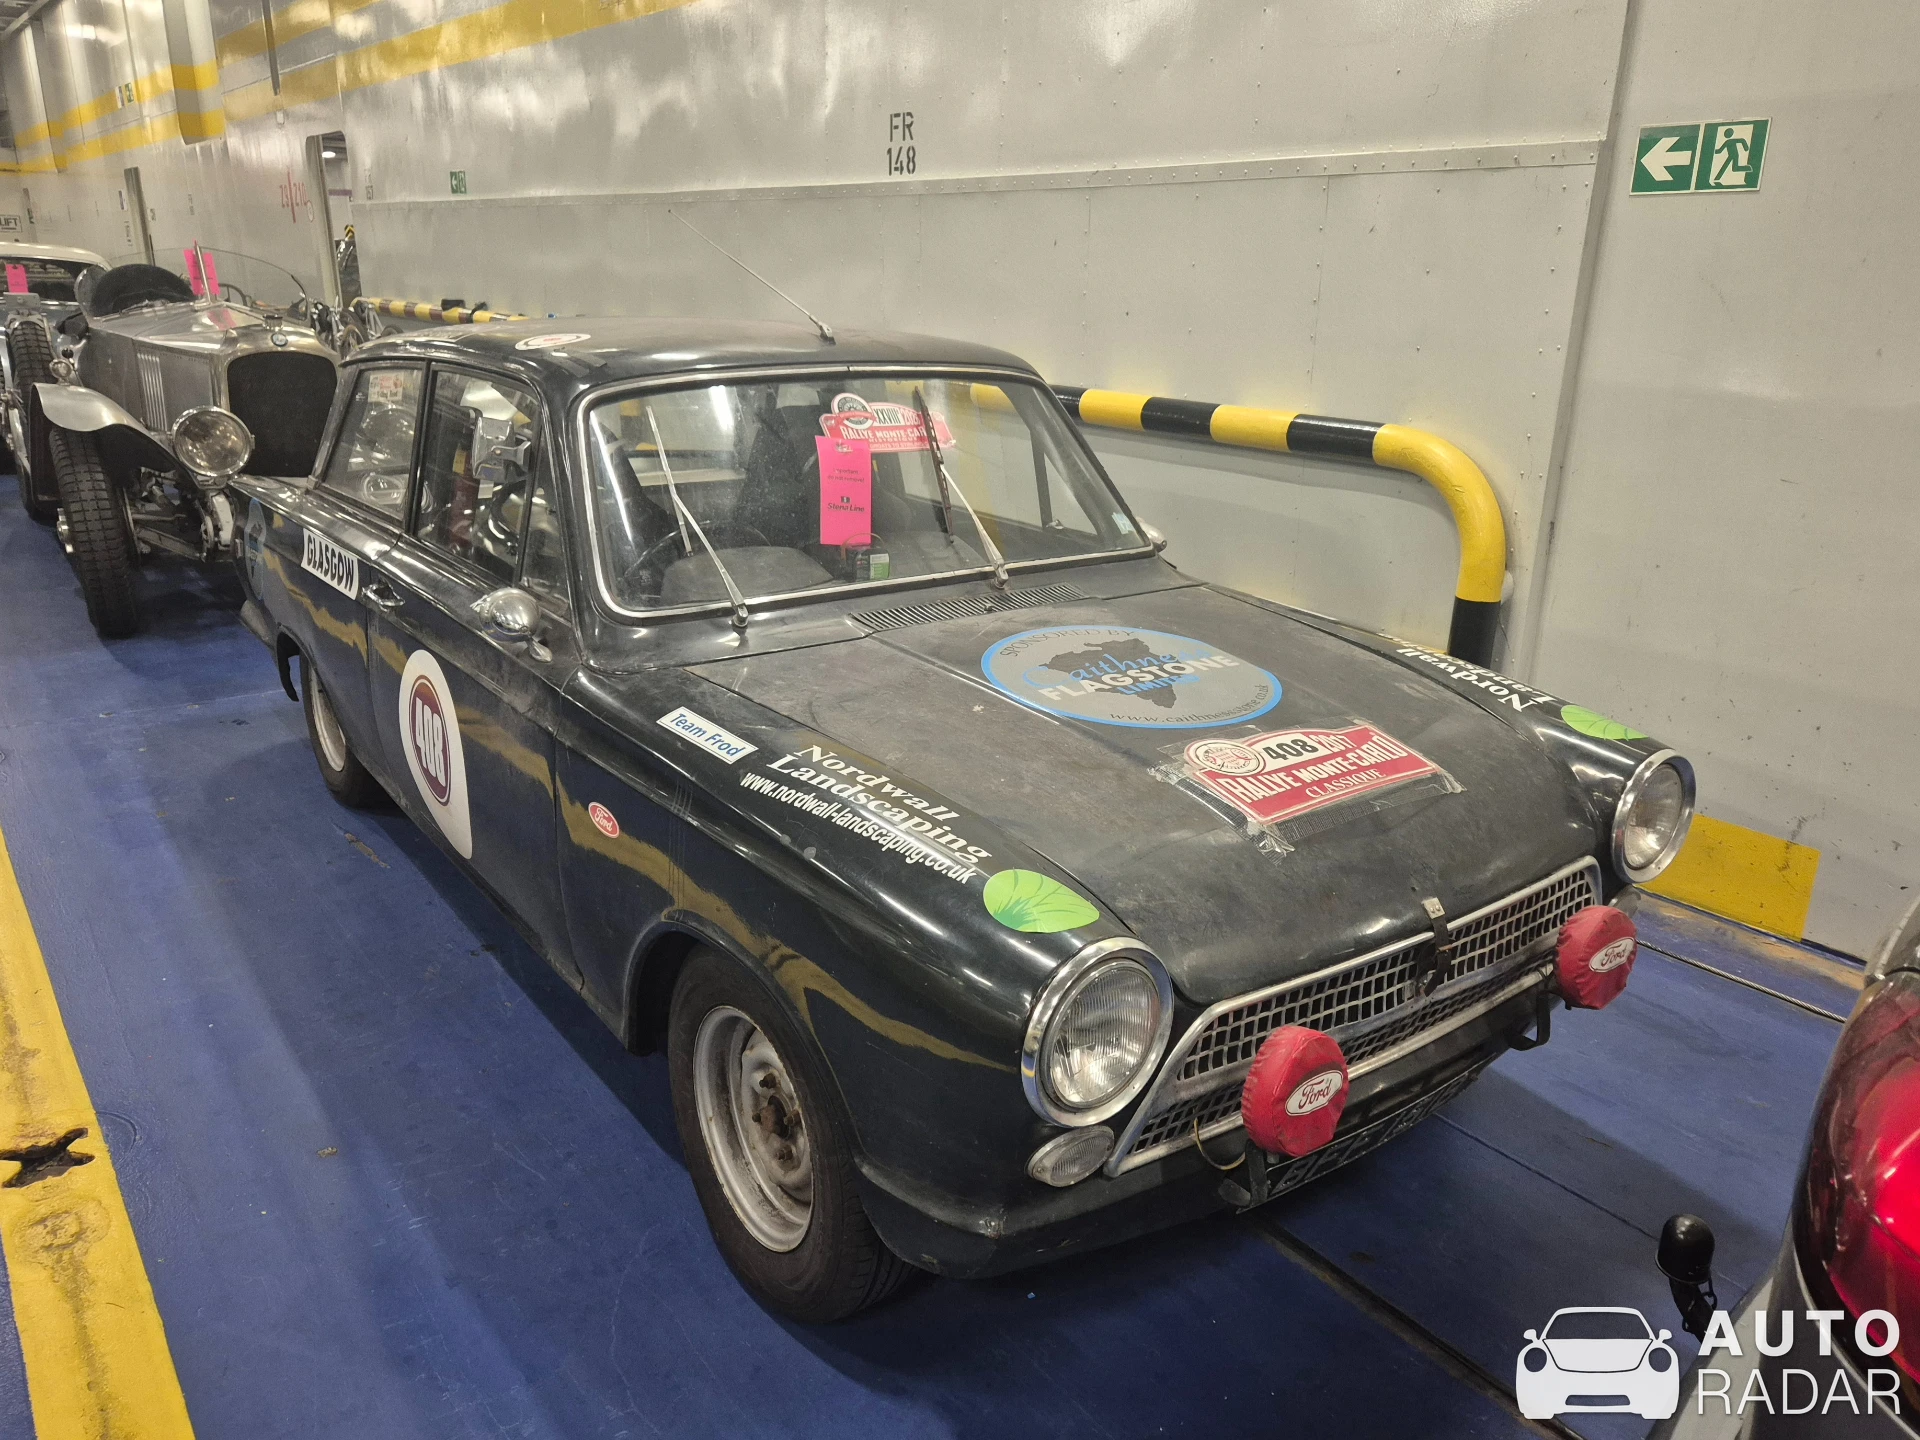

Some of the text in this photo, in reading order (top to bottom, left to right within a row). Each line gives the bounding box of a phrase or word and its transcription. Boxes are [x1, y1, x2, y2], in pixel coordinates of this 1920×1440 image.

[889, 111, 914, 142] FR
[887, 145, 916, 176] 148
[840, 426, 927, 440] RALLYE MONTE-CAR
[828, 502, 865, 512] Stena Line
[306, 534, 355, 592] GLASGOW
[1000, 628, 1135, 657] SPONSORED BY
[1038, 655, 1241, 701] FLAGSTONE
[1116, 673, 1201, 695] LIMIT
[1396, 648, 1537, 712] Nordwall
[415, 697, 446, 788] 408
[669, 713, 746, 758] Team Frod
[1262, 738, 1320, 761] 408
[1308, 734, 1358, 754] 2017
[793, 744, 961, 823] Nordwall
[1215, 771, 1303, 804] RALLYE
[1290, 734, 1409, 784] MONTE-CARLO
[1305, 768, 1387, 799] CLASSIQUE
[766, 753, 993, 865] Landscaping
[739, 771, 978, 886] www.nordwall-landscaping.co.uk
[1600, 942, 1628, 967] Ford
[1298, 1078, 1333, 1110] Ford
